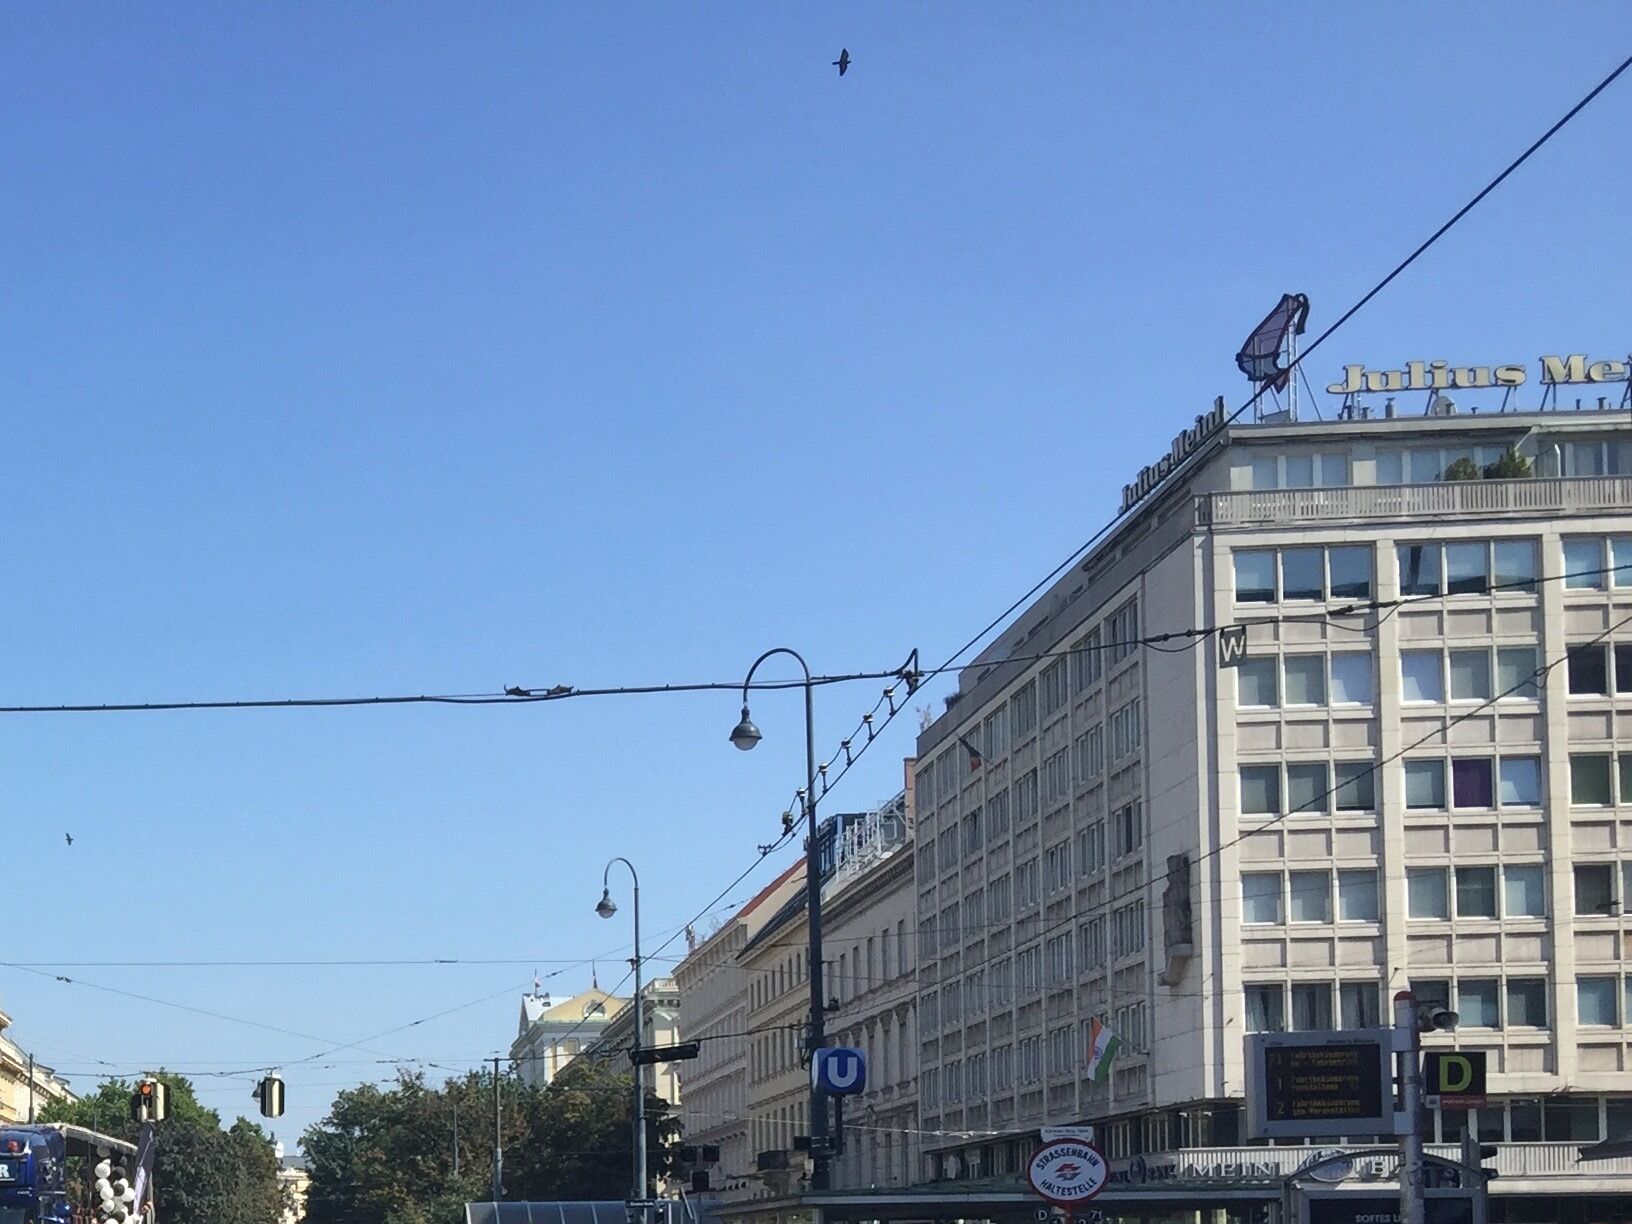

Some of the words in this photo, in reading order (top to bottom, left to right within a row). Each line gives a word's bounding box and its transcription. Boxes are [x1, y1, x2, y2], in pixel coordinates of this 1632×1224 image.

[1326, 360, 1528, 394] Julius
[1539, 353, 1632, 386] Me
[1118, 452, 1174, 515] Julius
[1171, 395, 1225, 462] Meinl
[1220, 635, 1246, 662] W
[828, 1056, 858, 1088] U
[1439, 1055, 1473, 1092] D
[1036, 1147, 1100, 1170] STRASSENBAHN
[1040, 1176, 1098, 1196] HALTESTELLE
